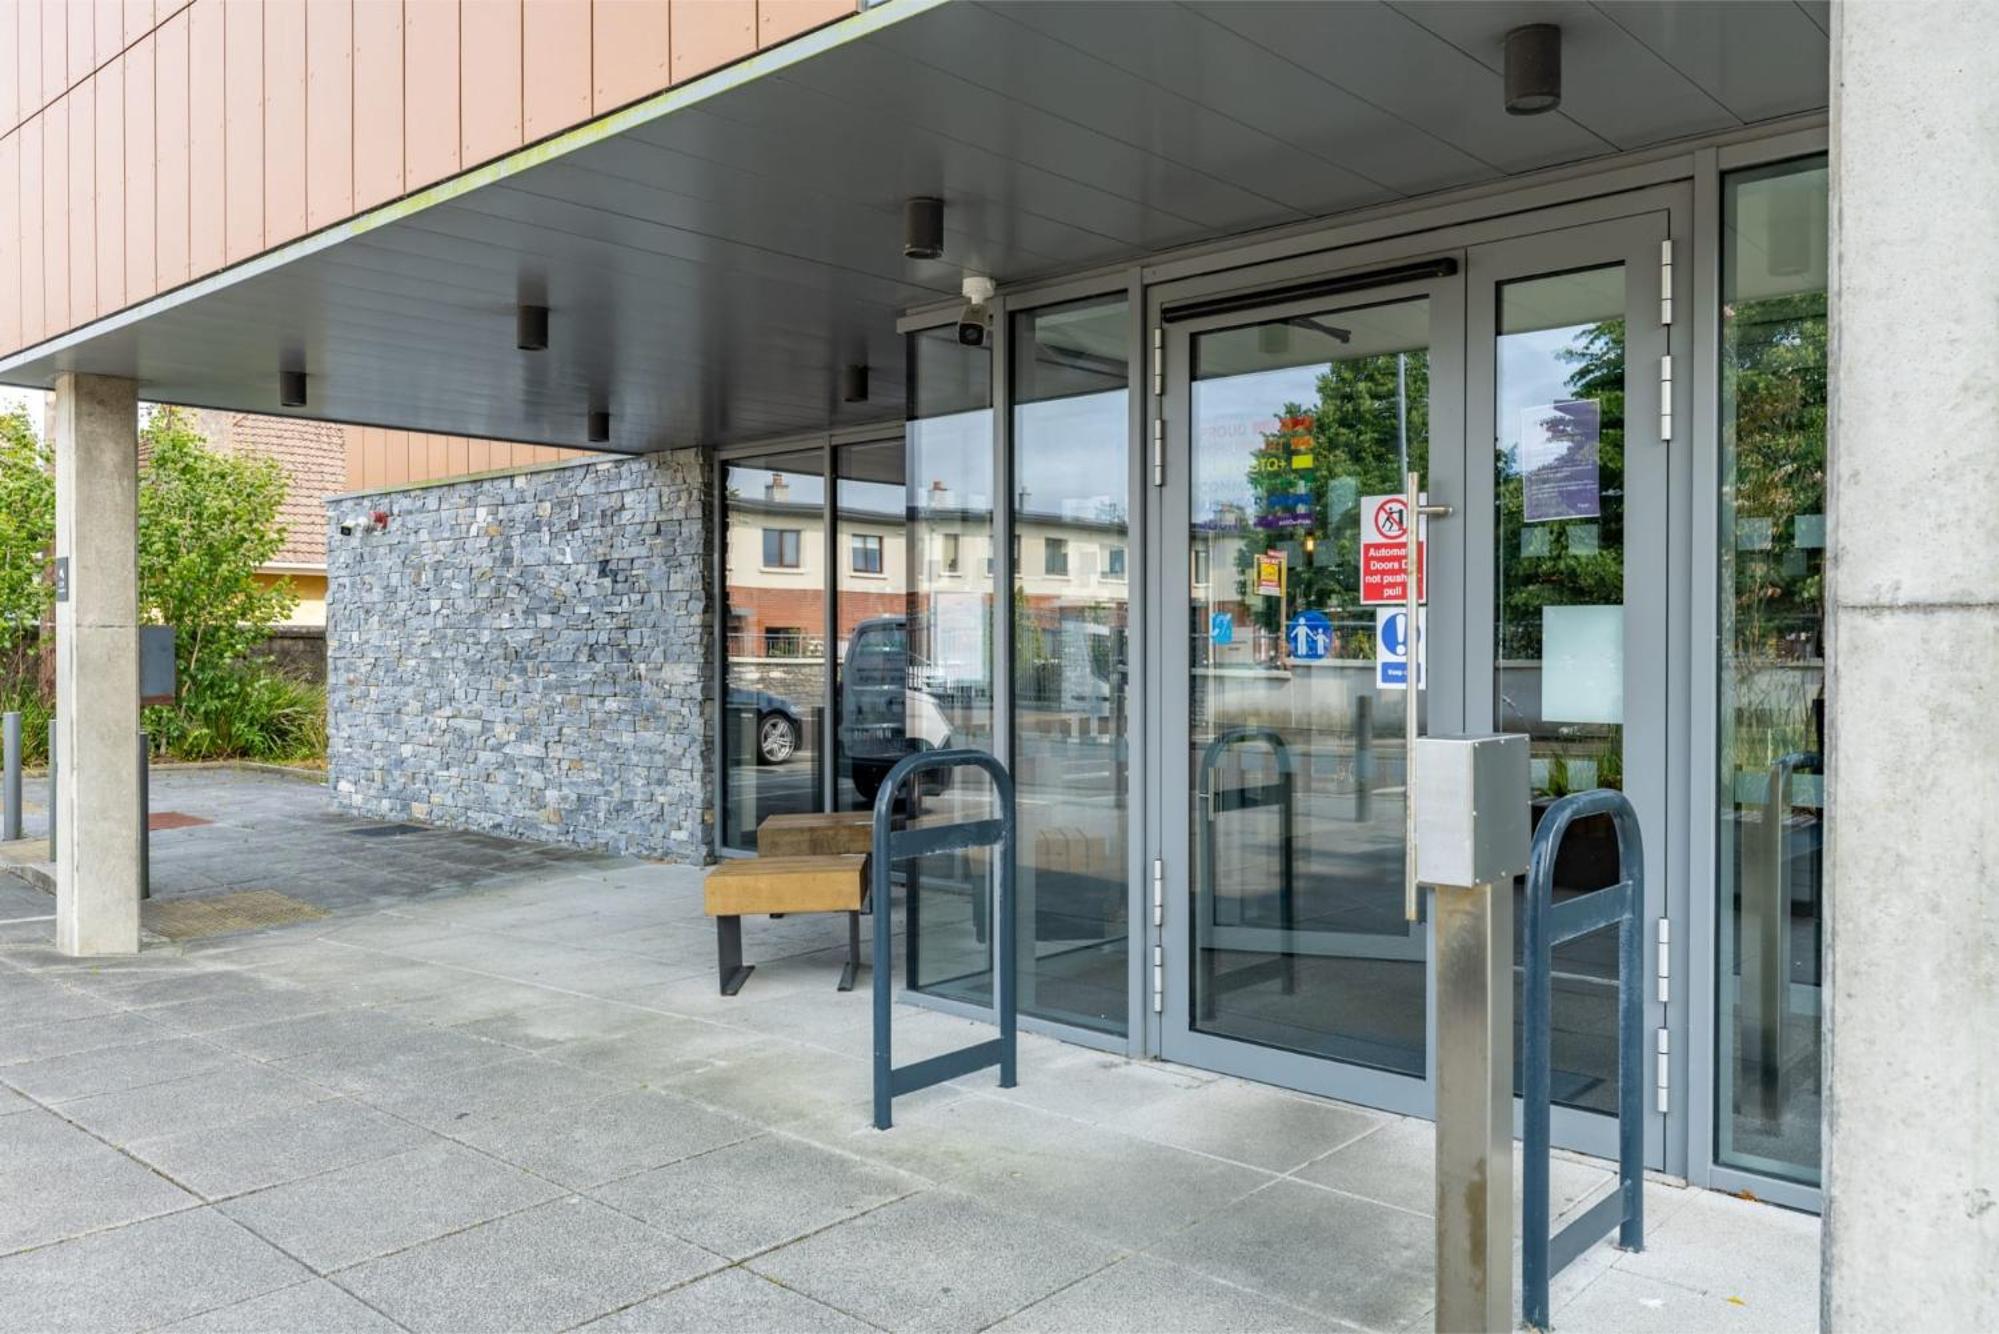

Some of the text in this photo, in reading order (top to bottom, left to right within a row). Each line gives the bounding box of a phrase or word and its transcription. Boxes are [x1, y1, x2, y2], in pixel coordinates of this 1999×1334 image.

[1368, 548, 1408, 557] Automa
[1370, 560, 1399, 570] Doors
[1365, 575, 1381, 584] not
[1382, 574, 1408, 585] push
[1383, 587, 1402, 598] pull
